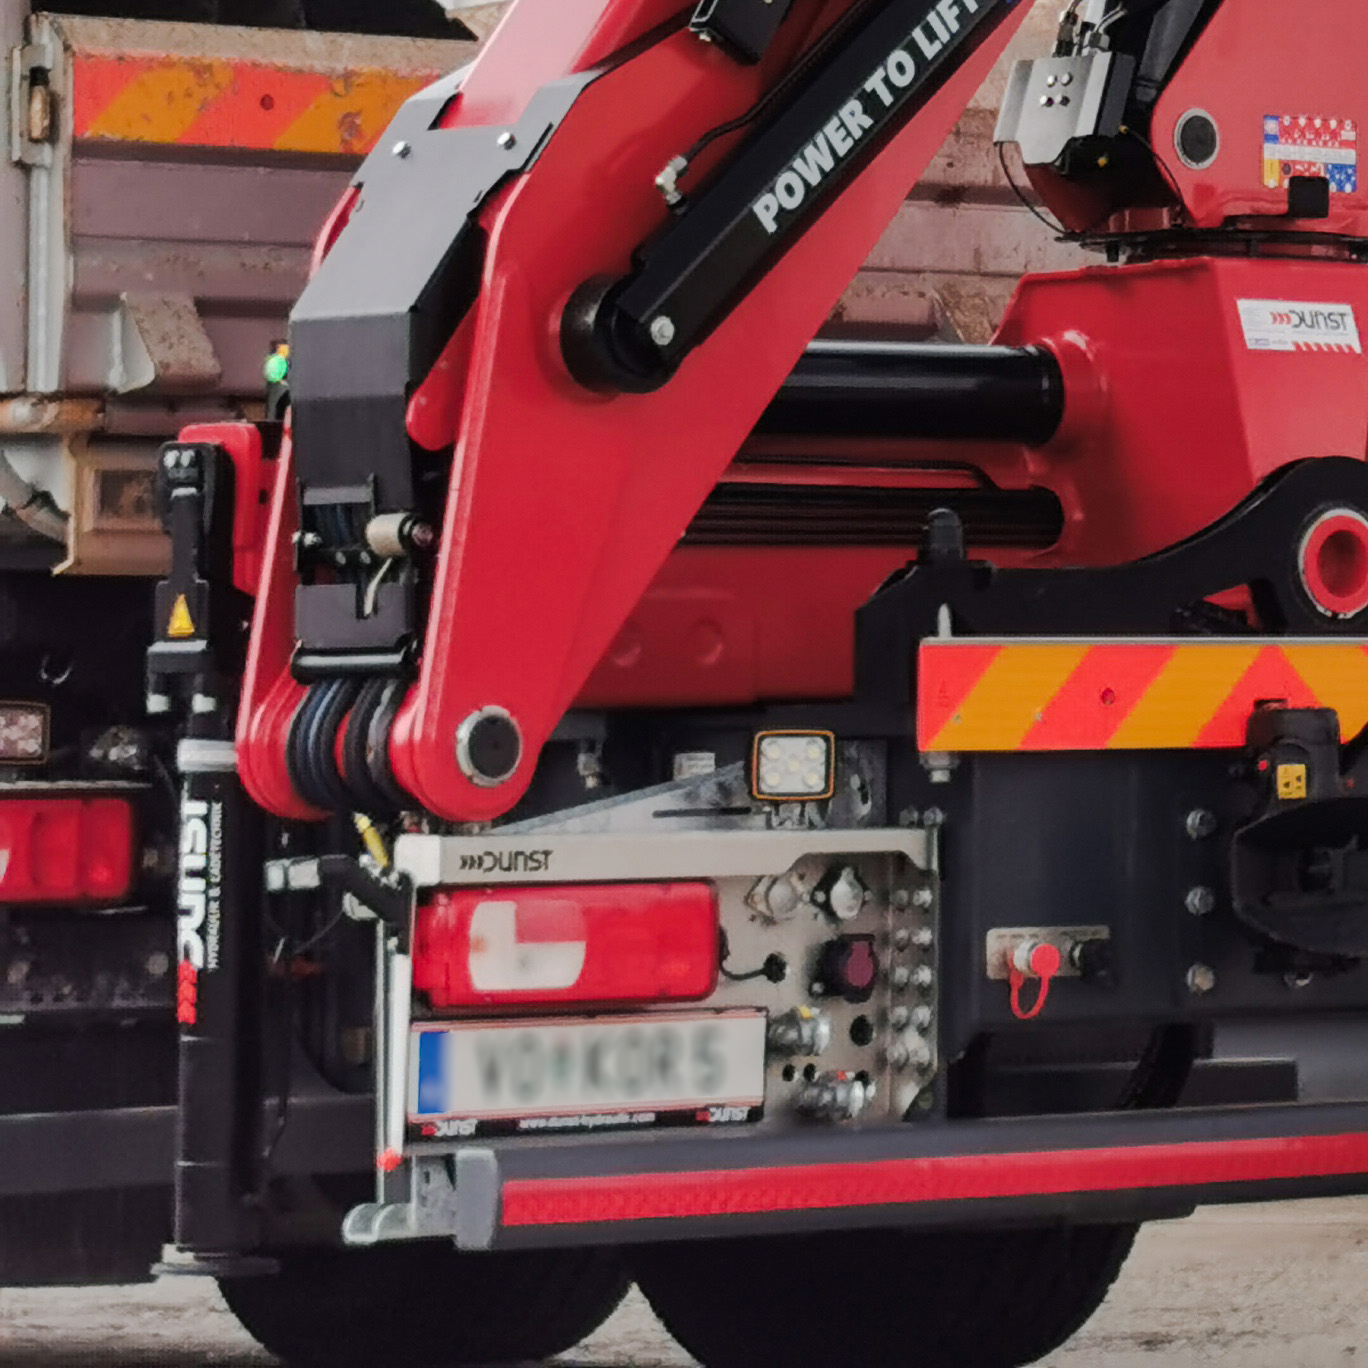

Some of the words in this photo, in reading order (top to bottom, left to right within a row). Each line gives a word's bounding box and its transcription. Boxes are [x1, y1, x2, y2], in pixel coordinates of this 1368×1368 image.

[752, 98, 874, 235] POWER
[864, 49, 916, 107] TO
[1289, 310, 1349, 331] DUNST
[177, 800, 207, 969] DUNST
[483, 850, 554, 873] DUNST
